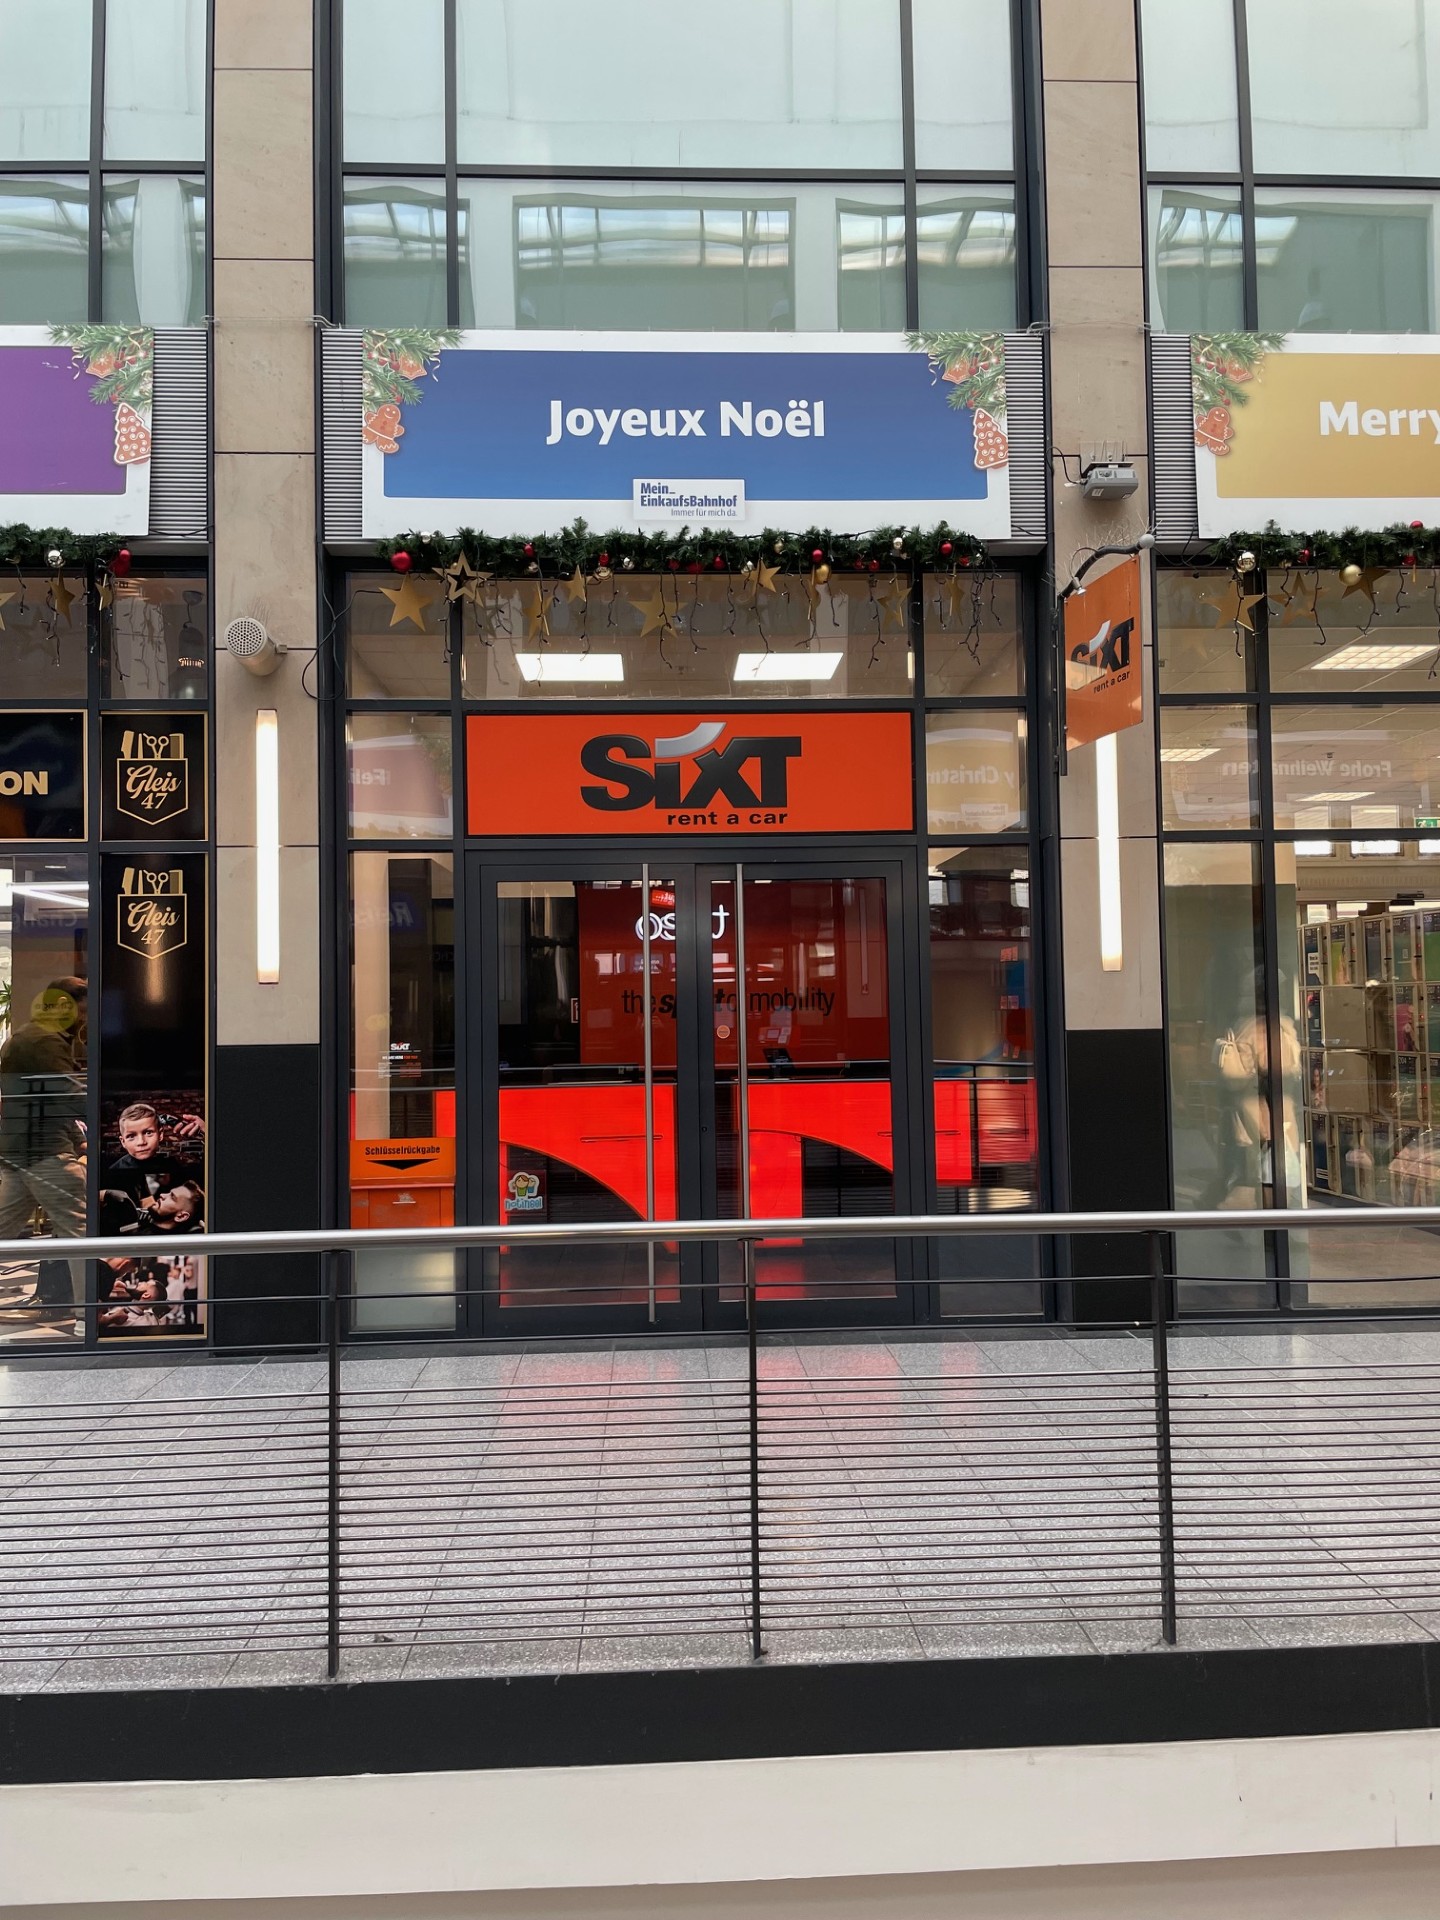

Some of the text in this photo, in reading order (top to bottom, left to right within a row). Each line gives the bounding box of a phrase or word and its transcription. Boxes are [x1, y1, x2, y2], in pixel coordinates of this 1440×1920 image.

[546, 399, 825, 445] Joyeux Noël
[640, 495, 738, 508] EinkaufsBahnhof
[671, 508, 694, 518] Immer
[696, 508, 706, 518] für
[708, 508, 726, 518] mich
[1093, 671, 1130, 694] rent a car
[126, 764, 181, 799] Gleis
[141, 792, 168, 810] 47
[667, 811, 788, 825] rent a car
[127, 900, 181, 934] Gleis
[141, 928, 166, 945] 47
[750, 987, 835, 1017] mobility
[365, 1145, 440, 1155] Schlüsselrückgabe
